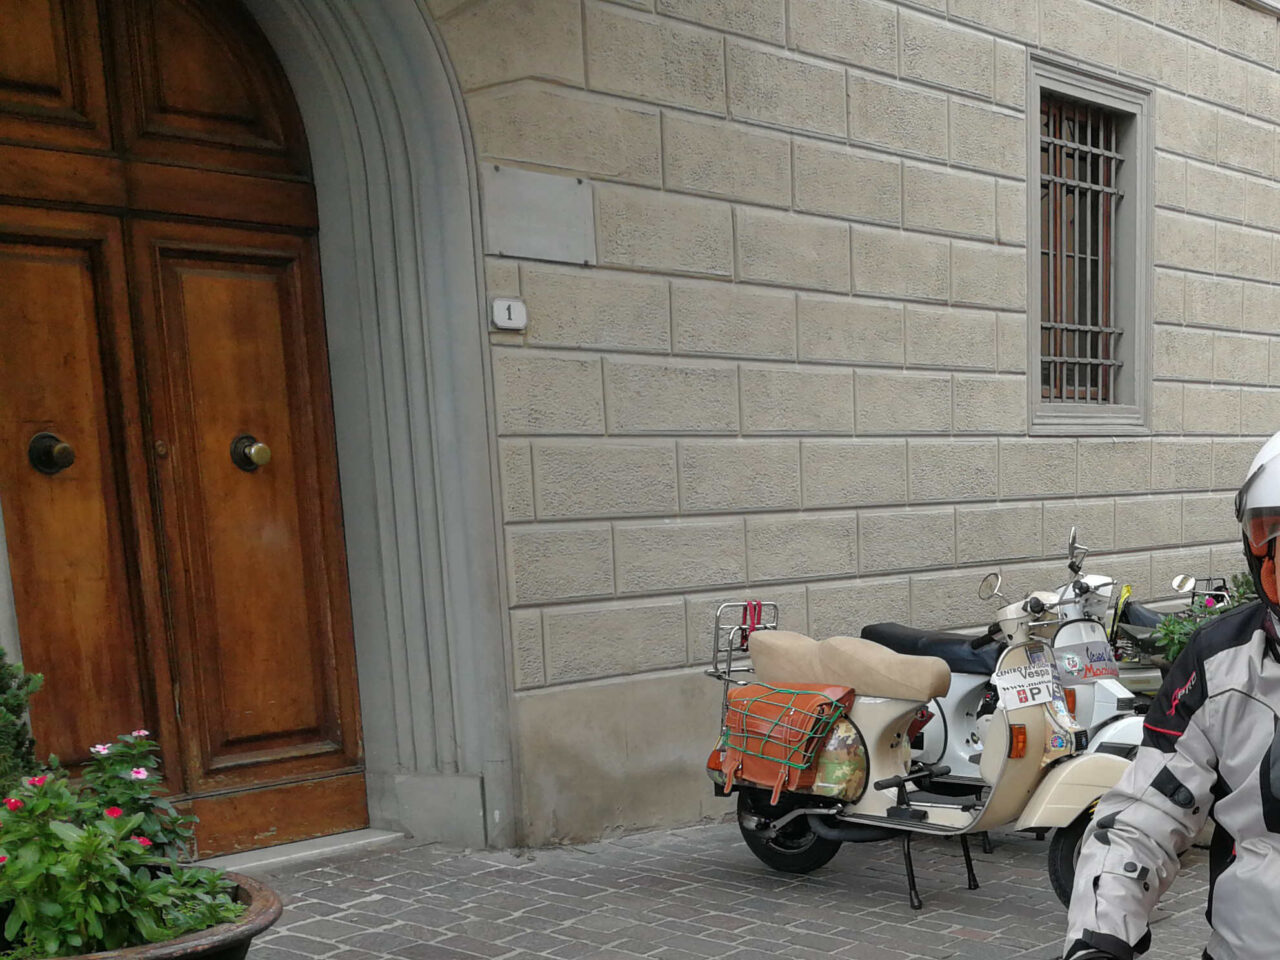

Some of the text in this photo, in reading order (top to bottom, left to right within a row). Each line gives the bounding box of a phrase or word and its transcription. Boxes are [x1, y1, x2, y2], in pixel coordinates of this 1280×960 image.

[506, 304, 512, 321] 1
[996, 667, 1023, 677] CENTRO
[1019, 668, 1050, 679] Vespa
